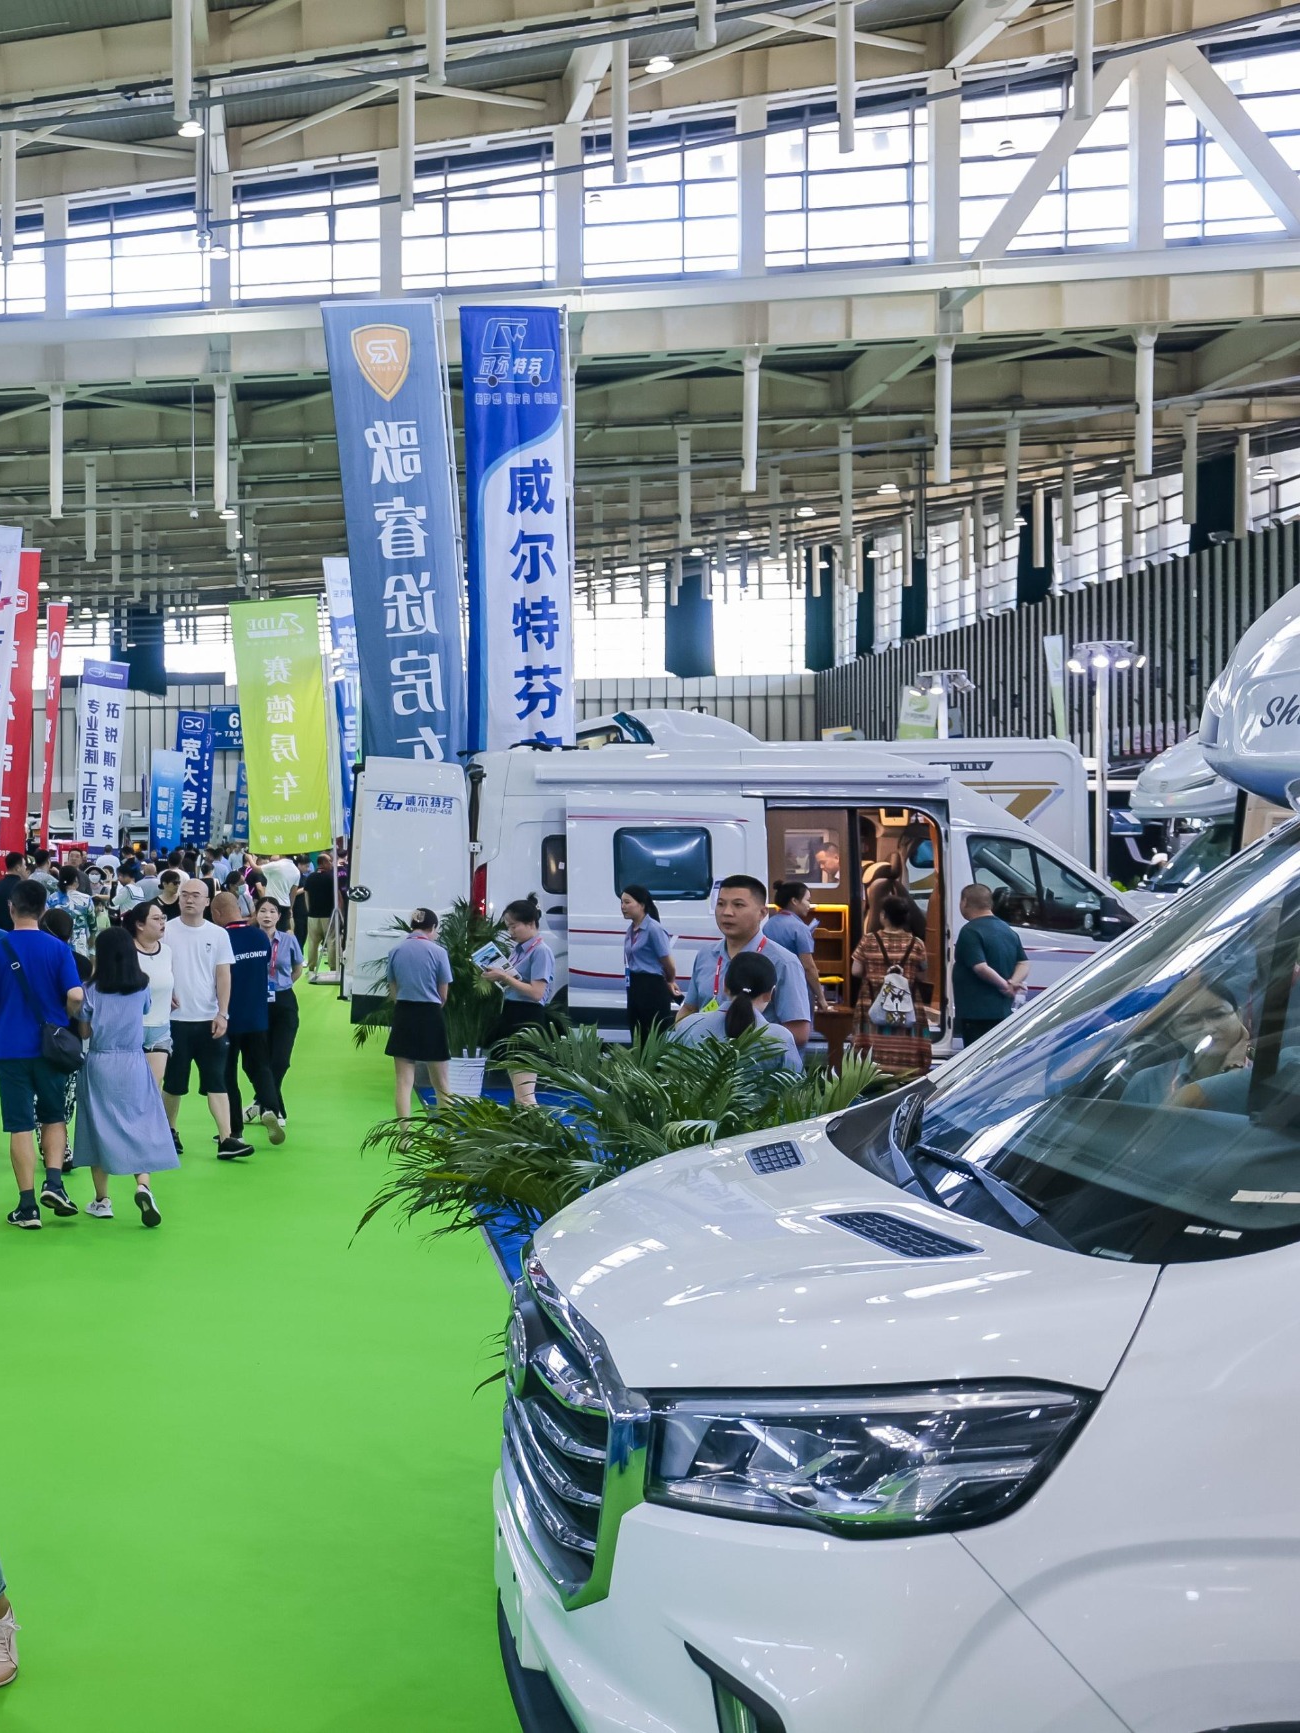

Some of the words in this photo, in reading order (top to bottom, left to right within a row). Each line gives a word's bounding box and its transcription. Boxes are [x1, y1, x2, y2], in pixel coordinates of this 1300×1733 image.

[1260, 694, 1300, 729] Sh
[102, 702, 120, 840] 拓锐斯特房车
[181, 738, 202, 838] 宽大房车
[405, 795, 454, 809] 威尔特芬
[234, 949, 268, 961] EWGONOW
